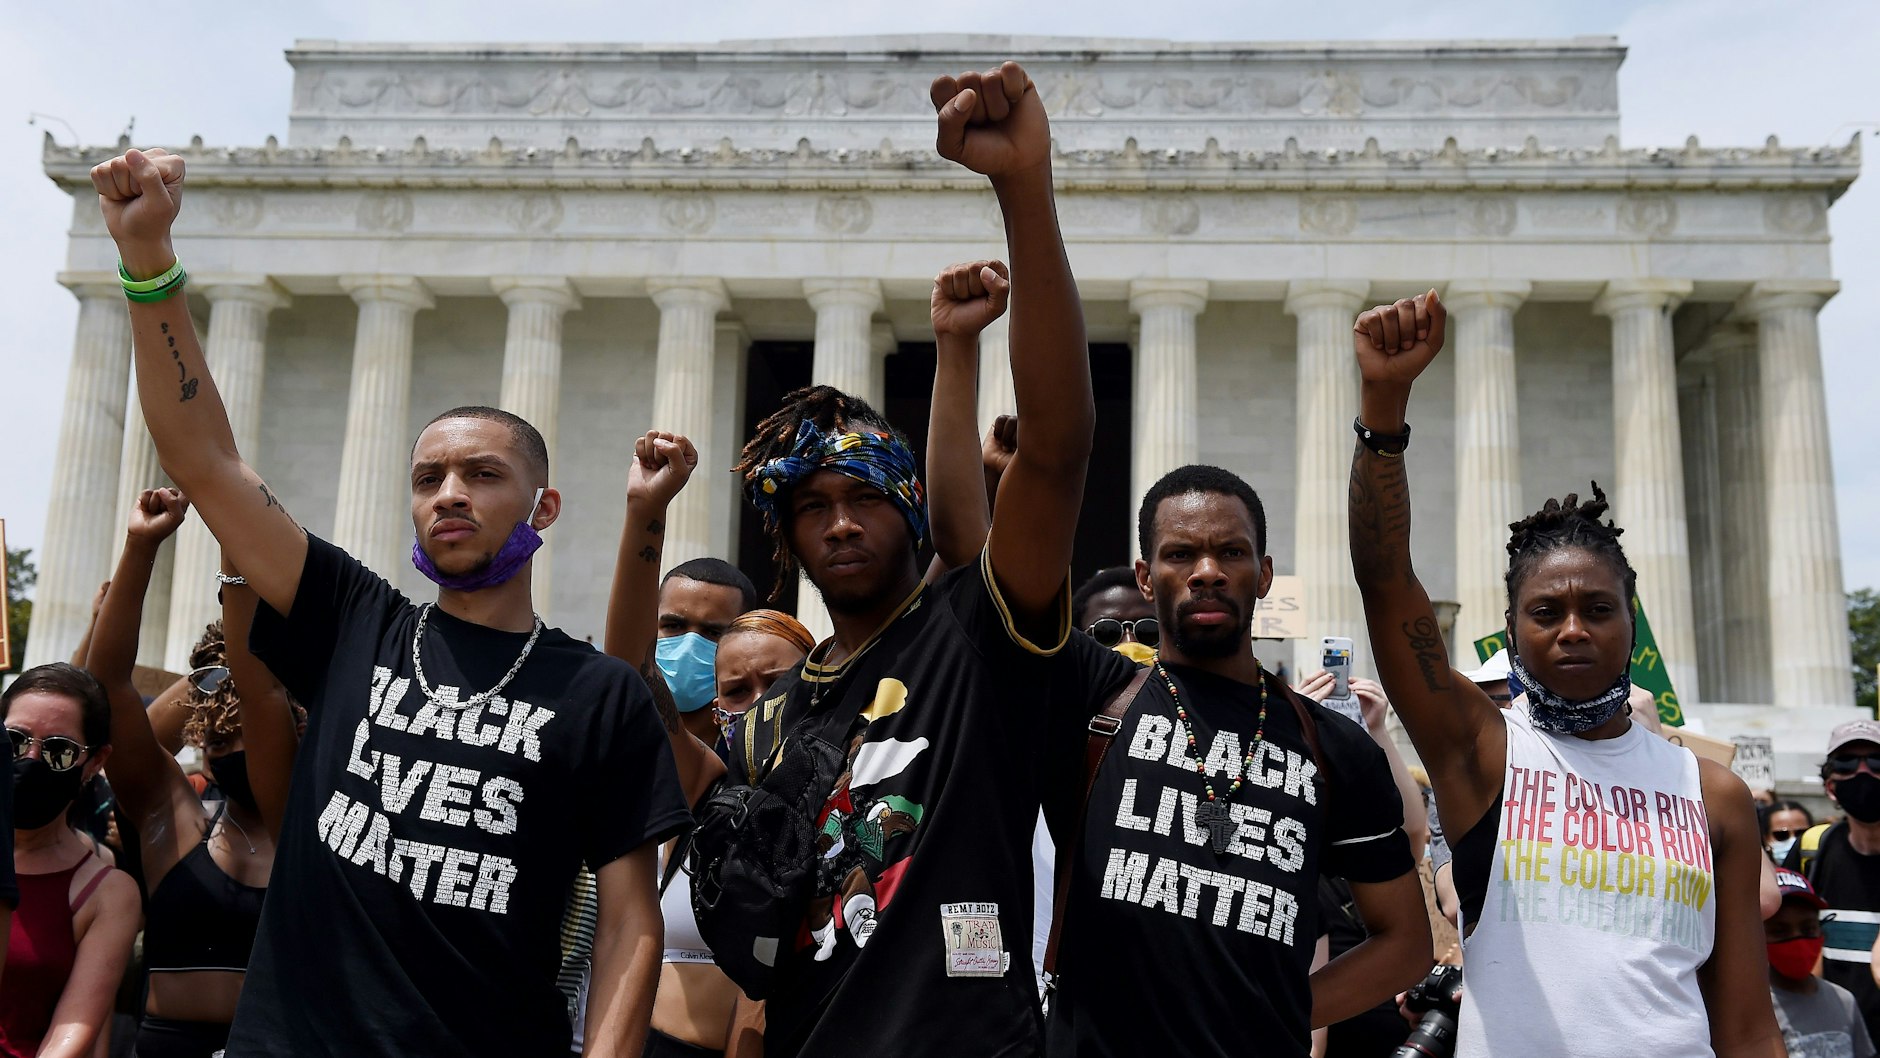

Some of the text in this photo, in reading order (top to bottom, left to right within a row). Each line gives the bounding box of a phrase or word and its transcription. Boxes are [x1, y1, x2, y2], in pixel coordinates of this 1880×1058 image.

[1257, 597, 1299, 611] ES
[1260, 617, 1291, 636] R
[1631, 646, 1658, 671] LM
[1128, 713, 1318, 806] BLACK
[1512, 767, 1709, 835] THE COLOR RUN
[1115, 778, 1306, 873] LIVES
[1505, 800, 1711, 873] THE COLOR RUN
[1100, 848, 1299, 946] MATTER
[1501, 839, 1711, 912] THE COLOR RUN
[947, 904, 973, 914] REMY
[966, 920, 995, 933] TRAP
[1498, 881, 1548, 922] THE
[1559, 885, 1655, 938] COLOR
[1661, 898, 1704, 950] RUN
[680, 951, 699, 960] Calvin
[967, 934, 997, 949] MUSIC
